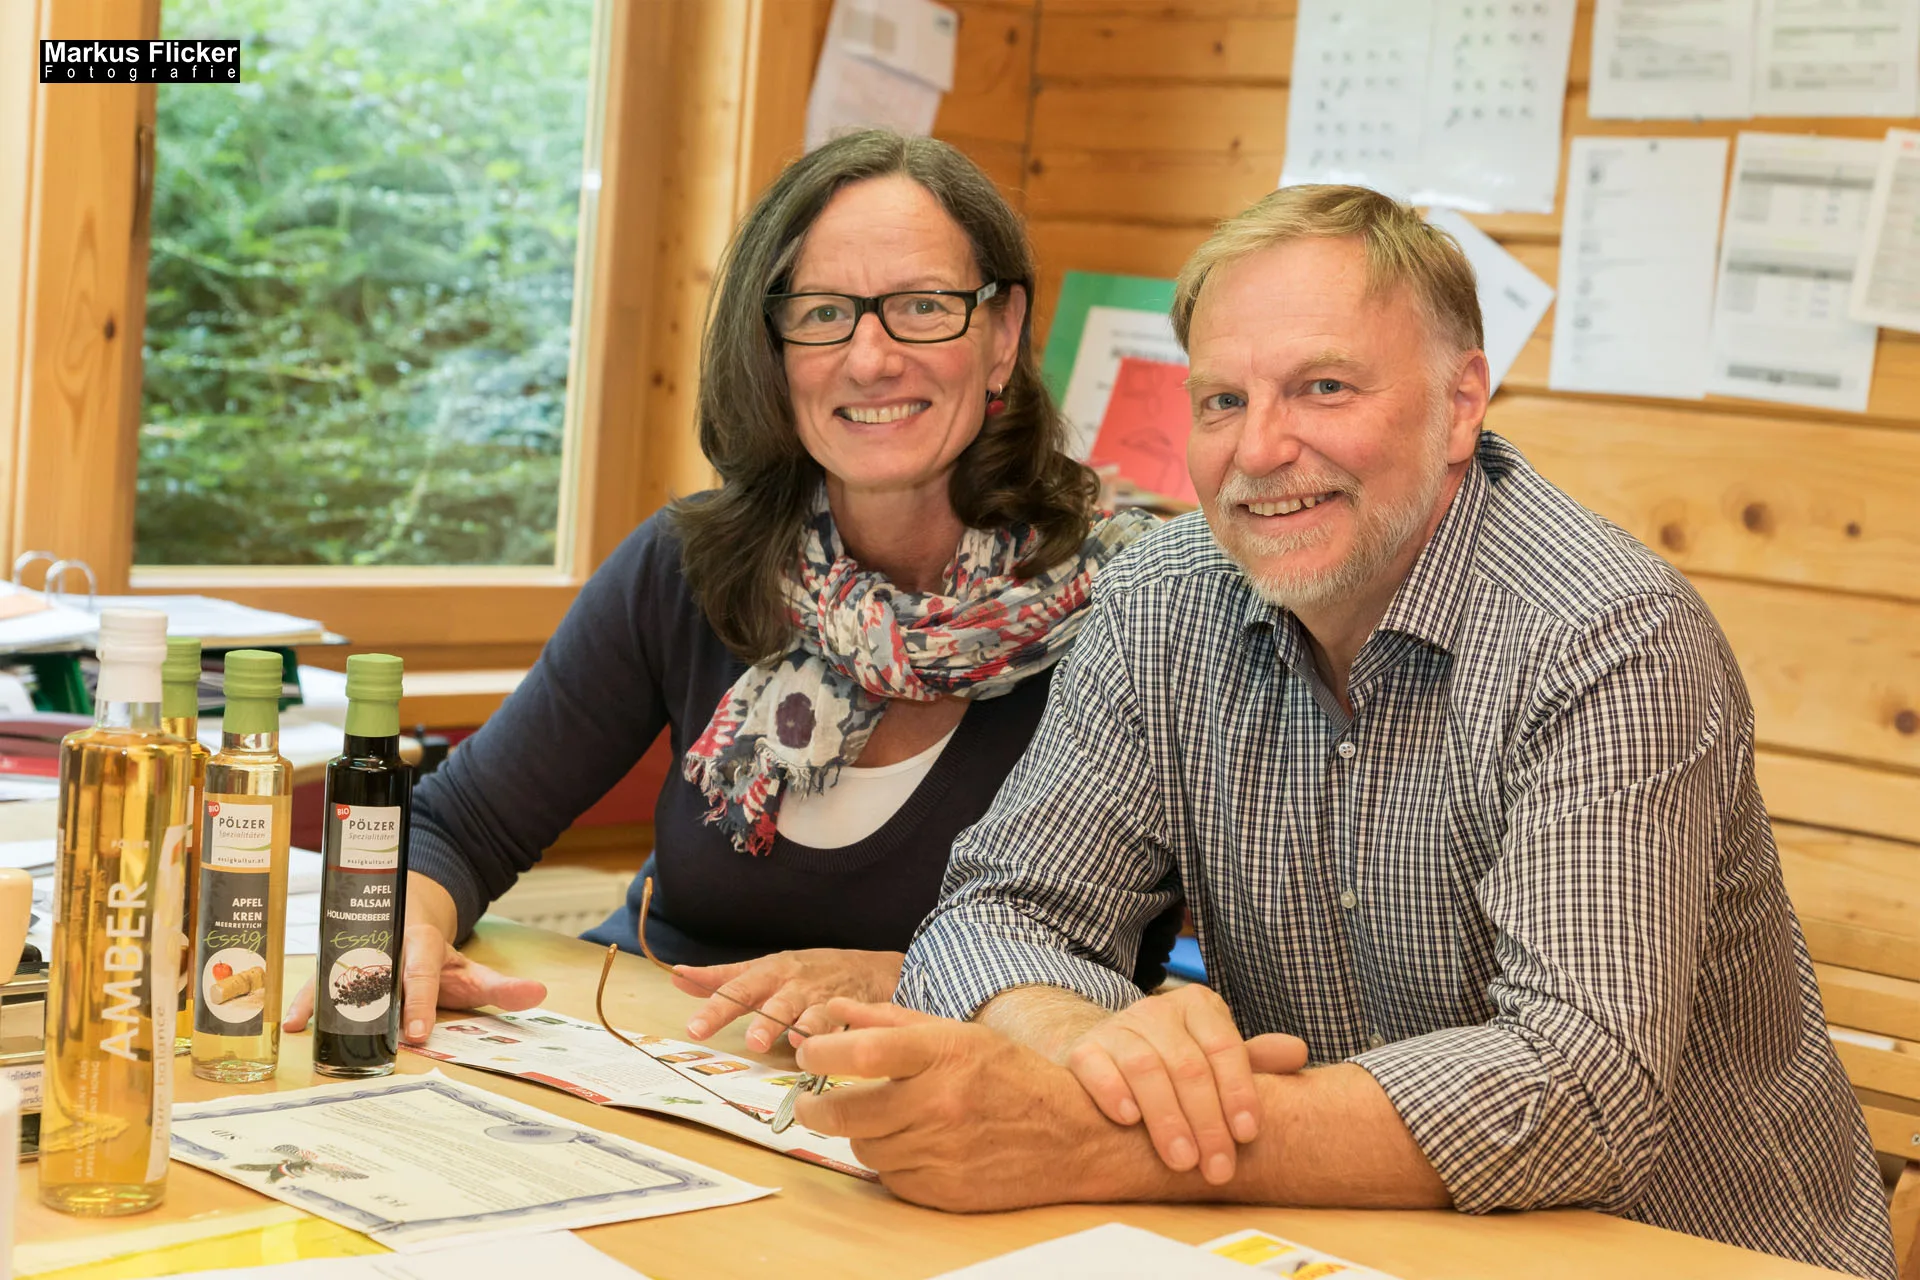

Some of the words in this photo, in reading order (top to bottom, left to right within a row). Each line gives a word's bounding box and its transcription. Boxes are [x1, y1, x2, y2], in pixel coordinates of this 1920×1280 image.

[208, 804, 219, 812] BIO
[219, 816, 265, 829] PÖLZER
[349, 819, 394, 831] PÖLZER
[363, 885, 392, 895] APFEL
[232, 898, 263, 907] APFEL
[350, 898, 391, 908] BALSAM
[233, 912, 262, 921] KREN
[327, 909, 390, 921] HOLUNDERBEERE
[215, 921, 262, 929] MEERRETTICH
[203, 930, 267, 954] Essig
[330, 930, 393, 954] Essig
[100, 881, 148, 1062] AMBER
[155, 1006, 167, 1087] balance
